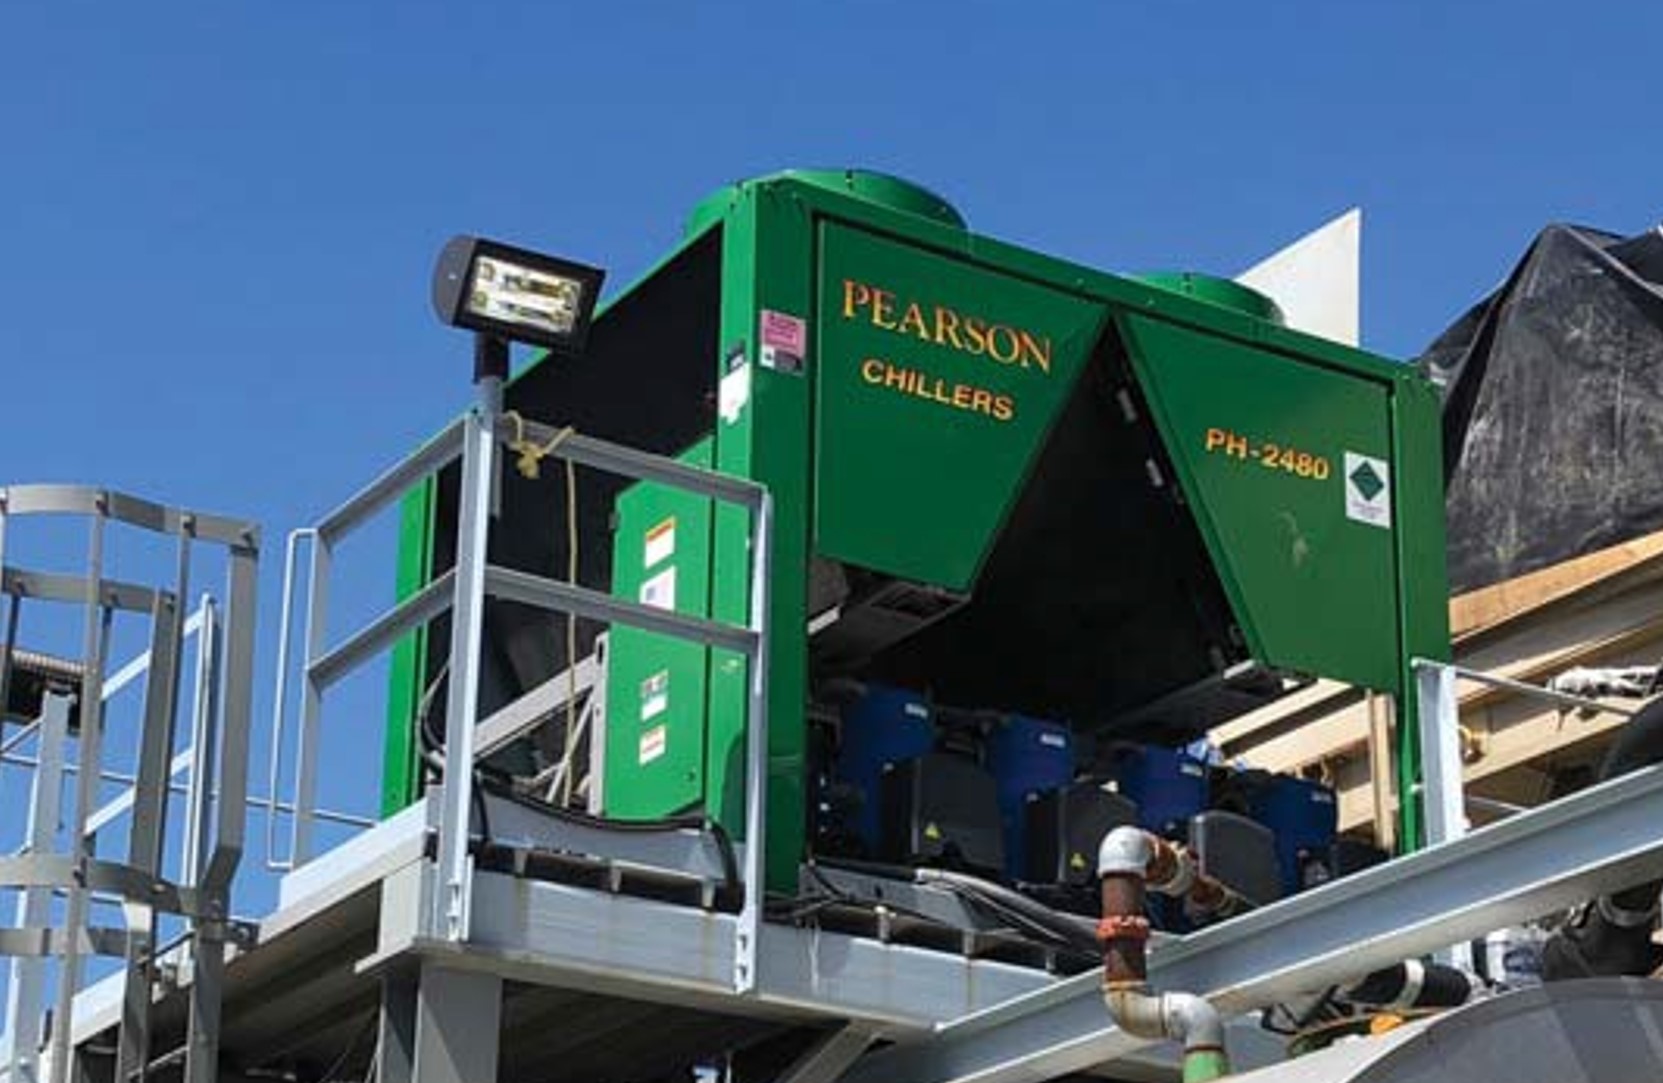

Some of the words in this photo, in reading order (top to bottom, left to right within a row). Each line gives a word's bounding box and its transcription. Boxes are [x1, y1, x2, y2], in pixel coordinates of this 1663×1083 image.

[842, 279, 1051, 373] PEARSON
[860, 358, 1014, 421] CHILLERS
[1206, 427, 1329, 480] PH-2480
